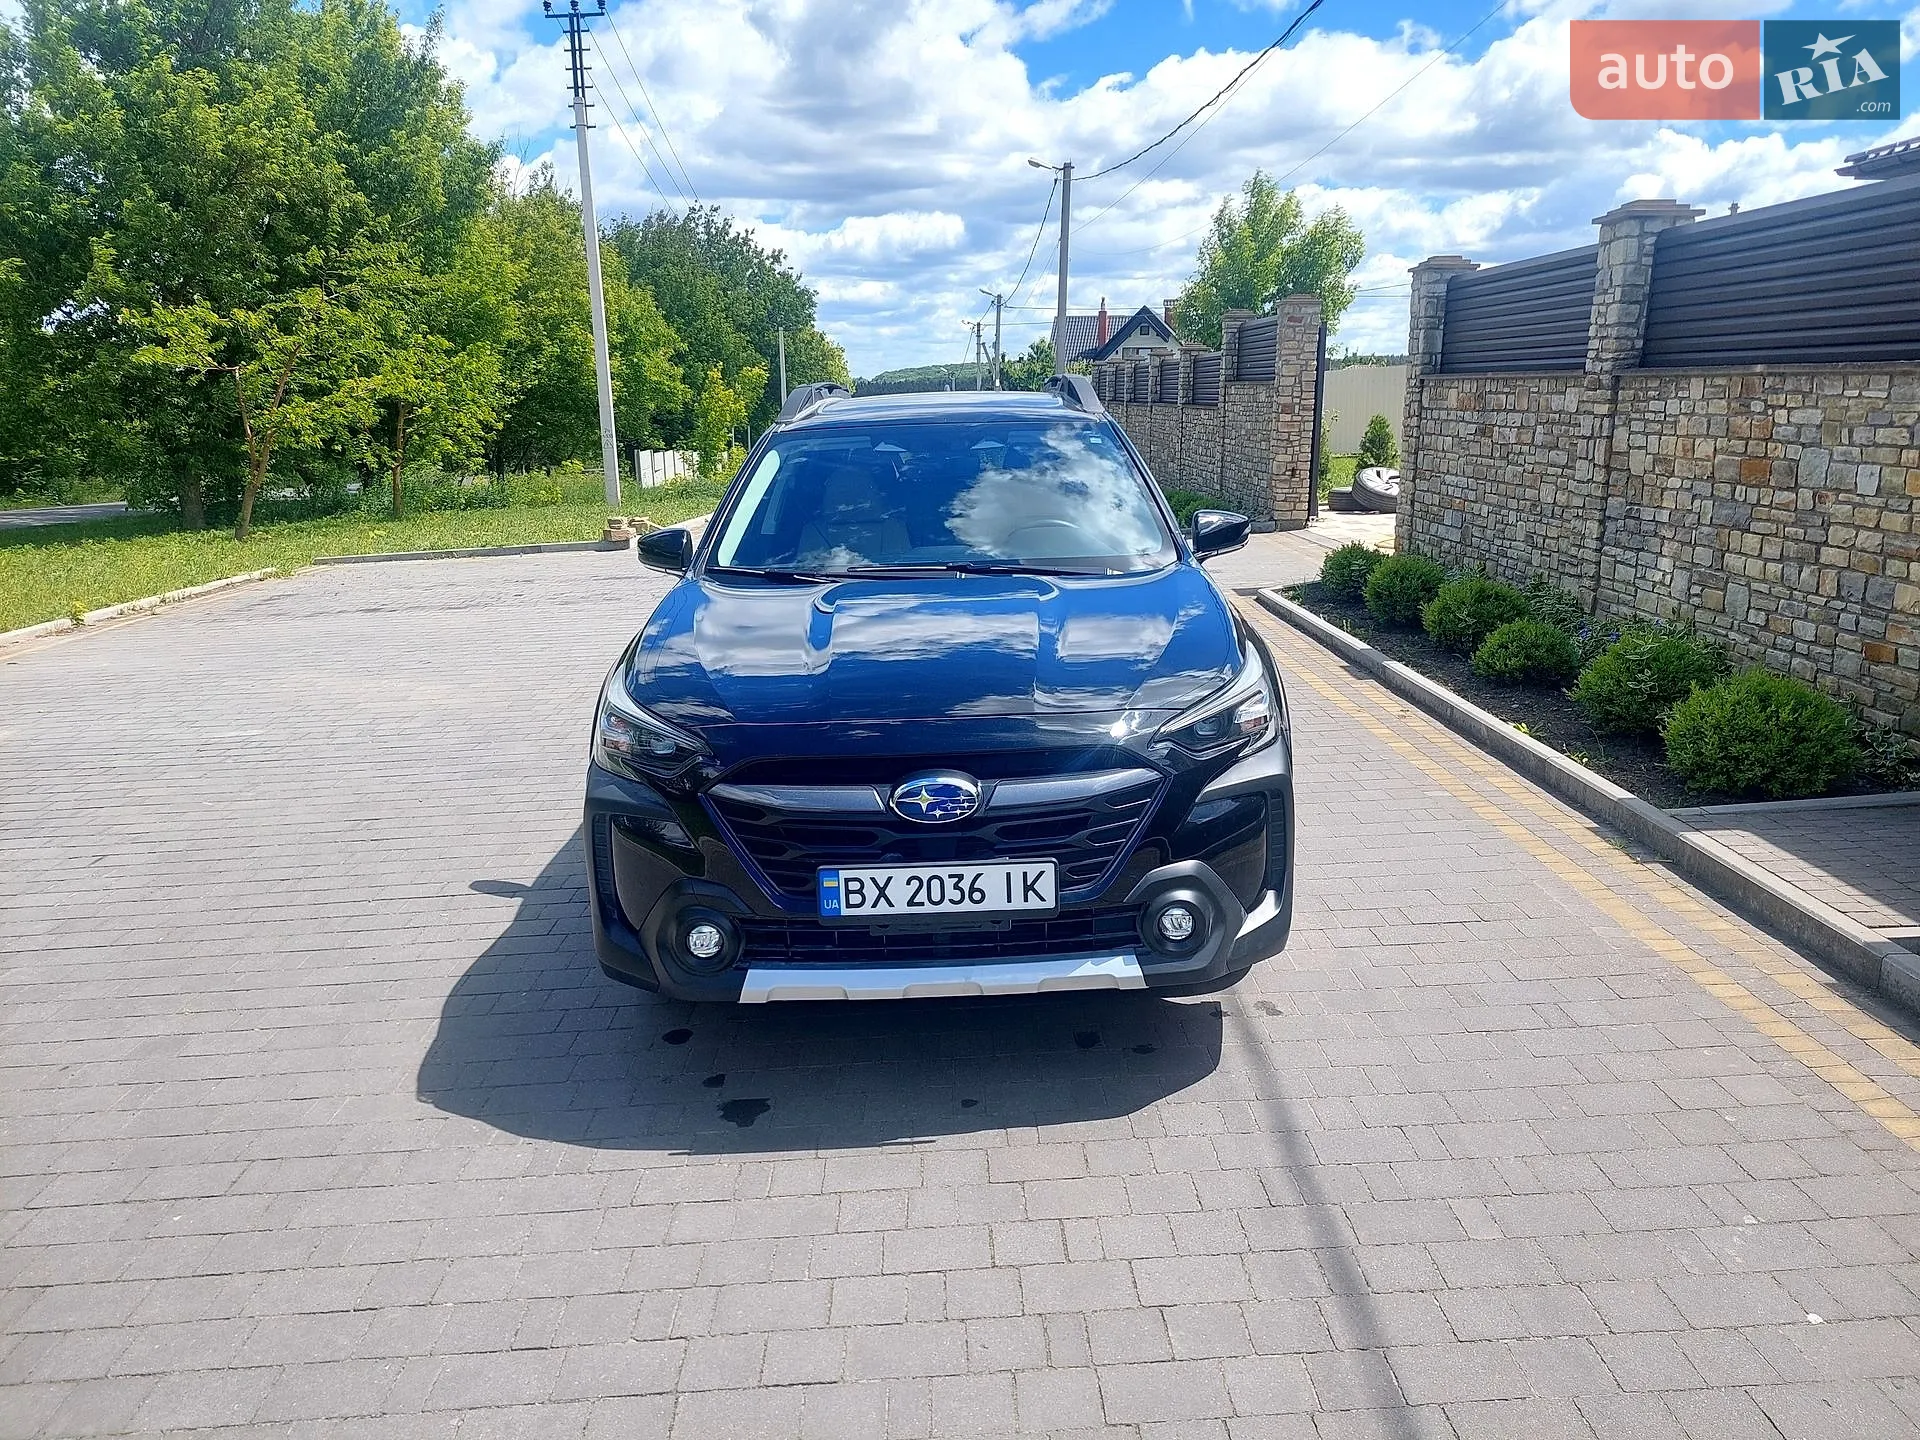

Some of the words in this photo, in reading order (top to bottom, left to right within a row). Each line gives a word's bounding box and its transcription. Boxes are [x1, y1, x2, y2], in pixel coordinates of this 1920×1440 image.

[844, 876, 895, 908] BX
[906, 872, 986, 907] 2036
[1006, 870, 1047, 903] IK
[823, 900, 839, 909] UA
